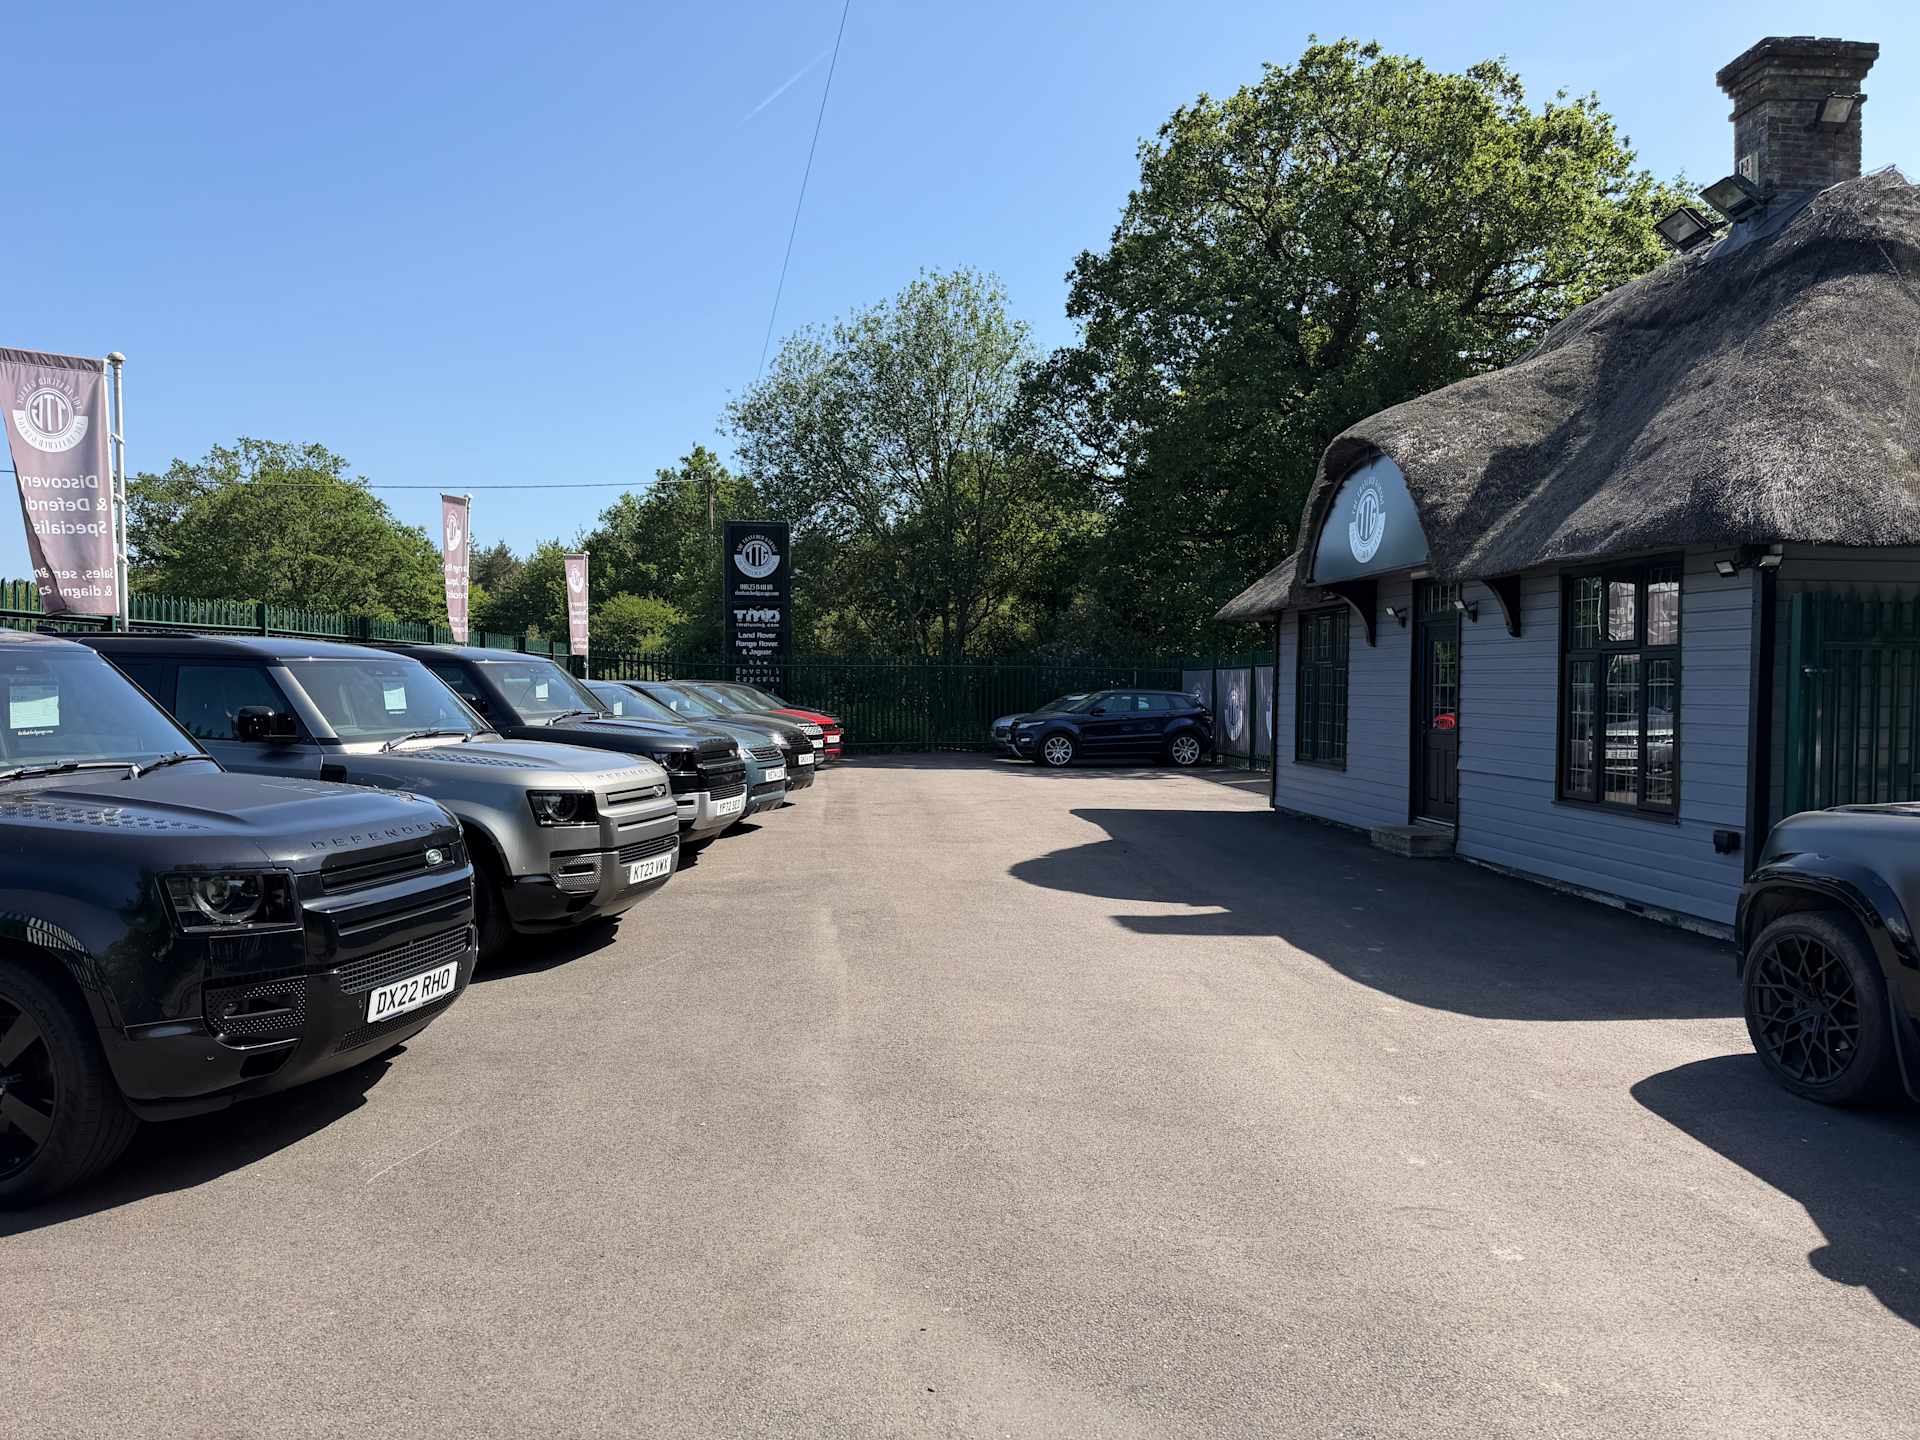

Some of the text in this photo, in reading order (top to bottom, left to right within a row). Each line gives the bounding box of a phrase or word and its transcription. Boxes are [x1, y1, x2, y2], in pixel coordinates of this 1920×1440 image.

[738, 631, 777, 639] Land Rover
[749, 648, 772, 656] Jaguar
[311, 820, 443, 849] DEFENDER
[633, 858, 656, 880] KT23
[376, 968, 450, 1015] DX22 RHO
